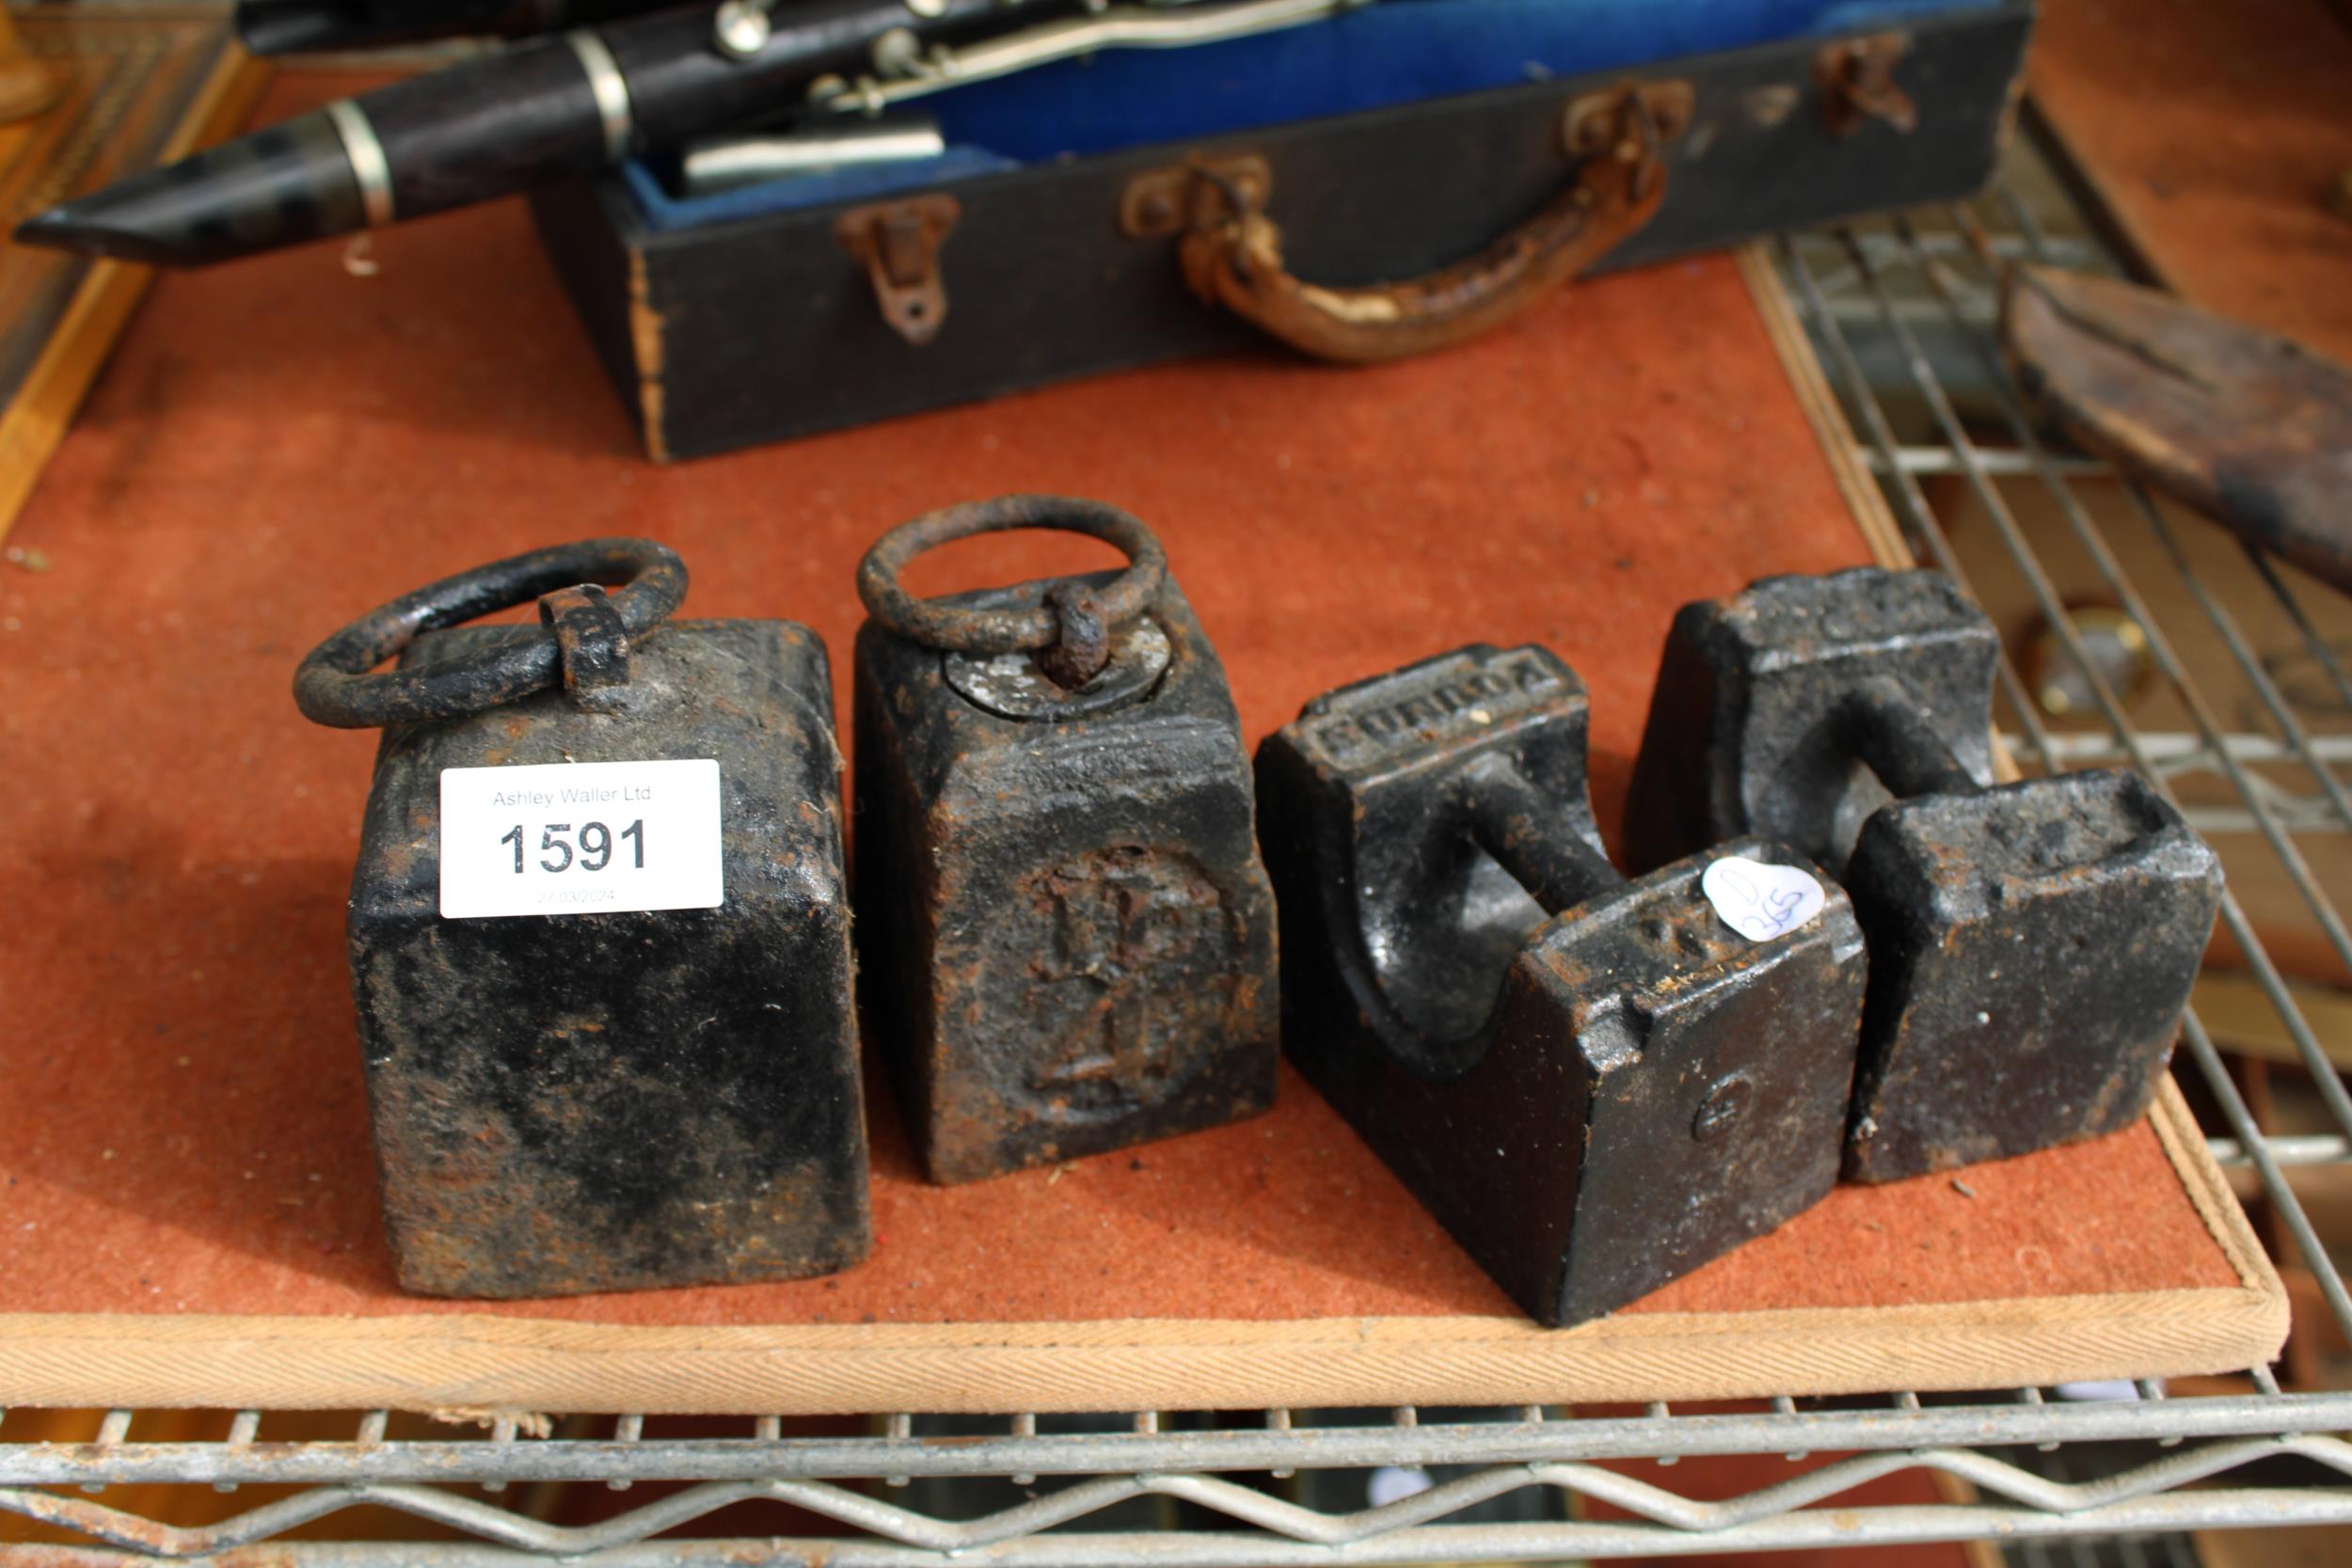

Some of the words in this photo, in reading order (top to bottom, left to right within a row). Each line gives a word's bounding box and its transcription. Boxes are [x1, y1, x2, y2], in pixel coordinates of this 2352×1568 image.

[492, 790, 554, 808] Ashley
[561, 786, 617, 804] Waller
[624, 784, 651, 800] Ltd
[501, 818, 644, 874] 1591
[536, 889, 615, 904] 2703/2024
